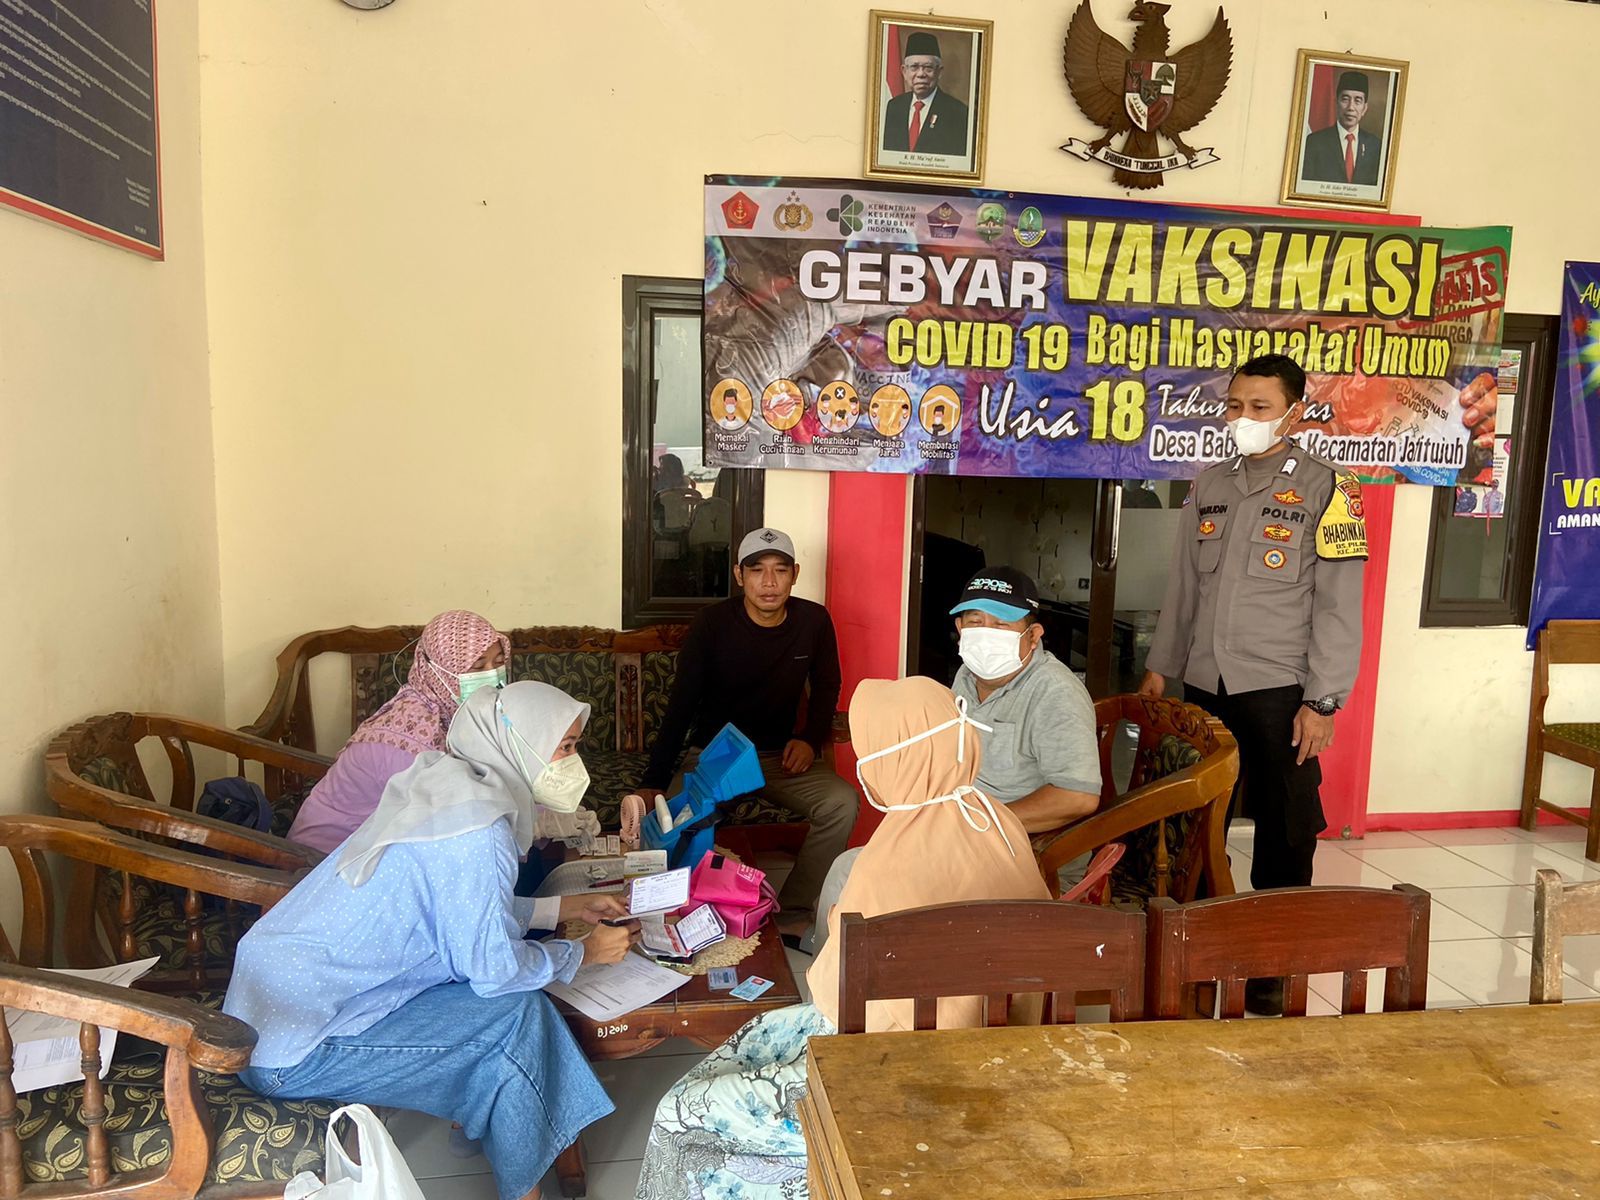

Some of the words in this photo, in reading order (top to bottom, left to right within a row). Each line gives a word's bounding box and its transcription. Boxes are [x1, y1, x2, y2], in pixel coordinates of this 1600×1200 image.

[868, 203, 917, 212] KEMENTRIAN
[868, 211, 916, 220] KESEHATAN
[867, 219, 915, 227] REPUBLIK
[867, 226, 908, 234] INDONESIA
[800, 249, 1047, 310] GEBYAR
[1065, 219, 1439, 316] VAKSINASI
[887, 318, 1014, 369] COVID
[1023, 324, 1068, 371] 19
[1087, 315, 1161, 371] Bagi
[1168, 319, 1357, 373] Masyarakat
[1362, 326, 1451, 377] Umum
[1396, 392, 1429, 420] COVID-19
[1411, 388, 1449, 421] VAKSINASI
[979, 382, 1079, 440] Usia
[1086, 380, 1145, 442] 18
[714, 433, 749, 444] Memakai
[812, 435, 860, 447] Menghindari
[717, 442, 747, 452] Masker
[781, 445, 805, 455] Tangan
[814, 445, 858, 455] Kerumunan
[918, 441, 960, 451] Membatasi
[1153, 429, 1196, 458] Desa
[1308, 433, 1396, 463] Kecamatan
[1400, 436, 1463, 465] Jatitujuh
[879, 448, 900, 458] Jarak
[920, 449, 956, 460] Mobilitas
[1261, 506, 1306, 524] POLRI
[597, 1026, 608, 1038] BJ
[609, 1024, 628, 1035] 2010
